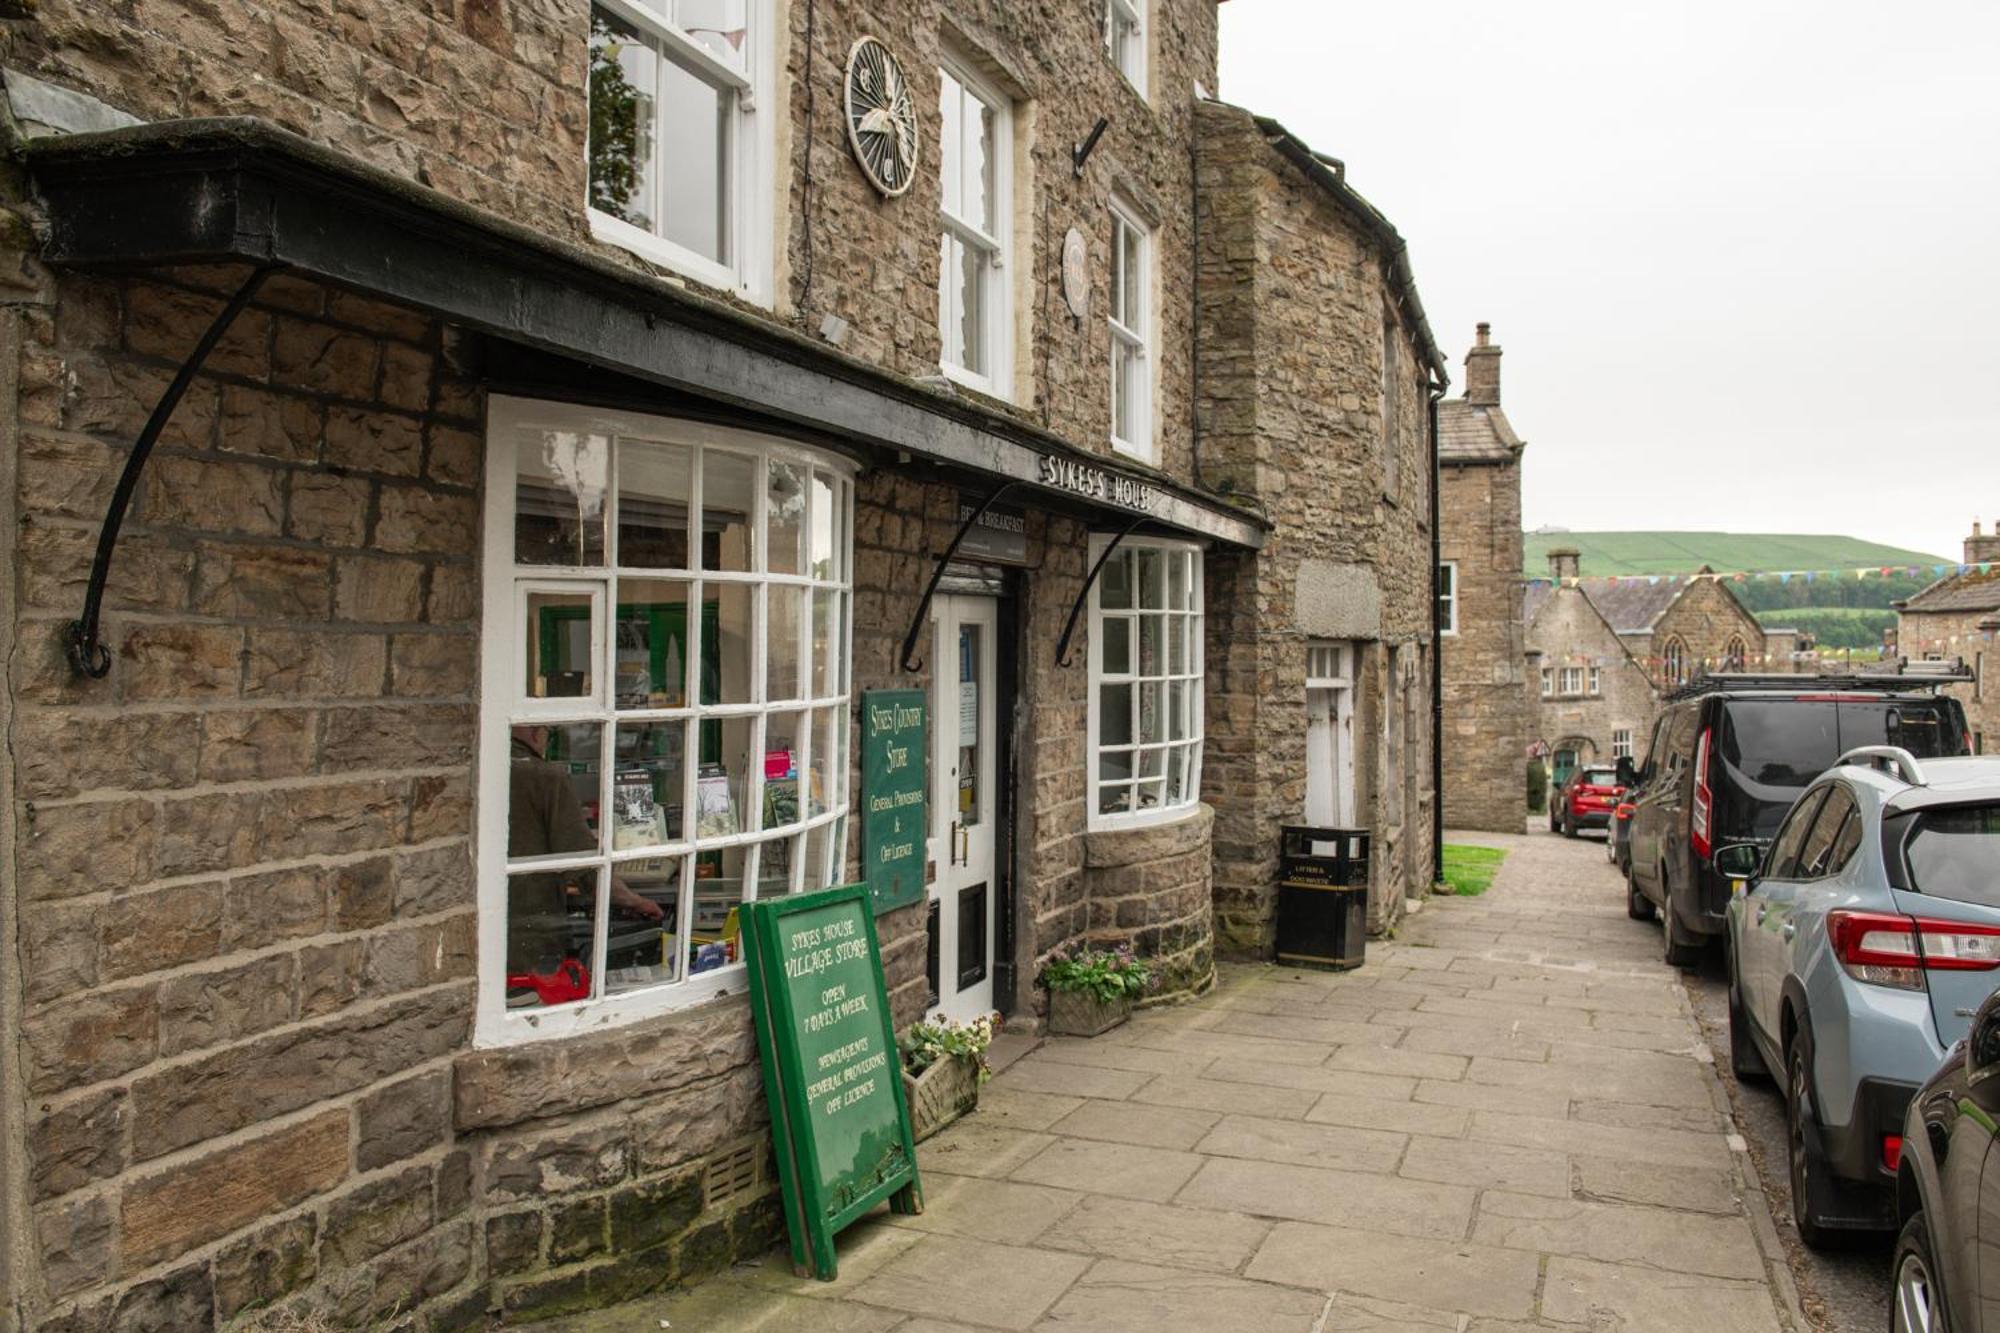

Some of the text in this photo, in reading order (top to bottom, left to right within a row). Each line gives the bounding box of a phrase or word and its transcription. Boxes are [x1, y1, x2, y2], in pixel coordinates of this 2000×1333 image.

[1048, 455, 1104, 497] SYKES'S
[985, 511, 1025, 534] BREAKFAST
[893, 703, 922, 735] COUNTRY
[886, 739, 908, 774] STORE
[870, 793, 893, 813] GENERAL
[894, 815, 901, 833] &
[791, 919, 855, 951] SYKES HOUSE
[784, 938, 869, 978] VILLAGE STORE
[821, 984, 847, 1006] OPEN
[803, 995, 869, 1034] 7 DAYS A WEEK
[818, 1037, 869, 1072] NEWSAGENTS
[806, 1051, 886, 1105] GENERAL PROVISIONS
[826, 1079, 876, 1115] OFF LICENCE
